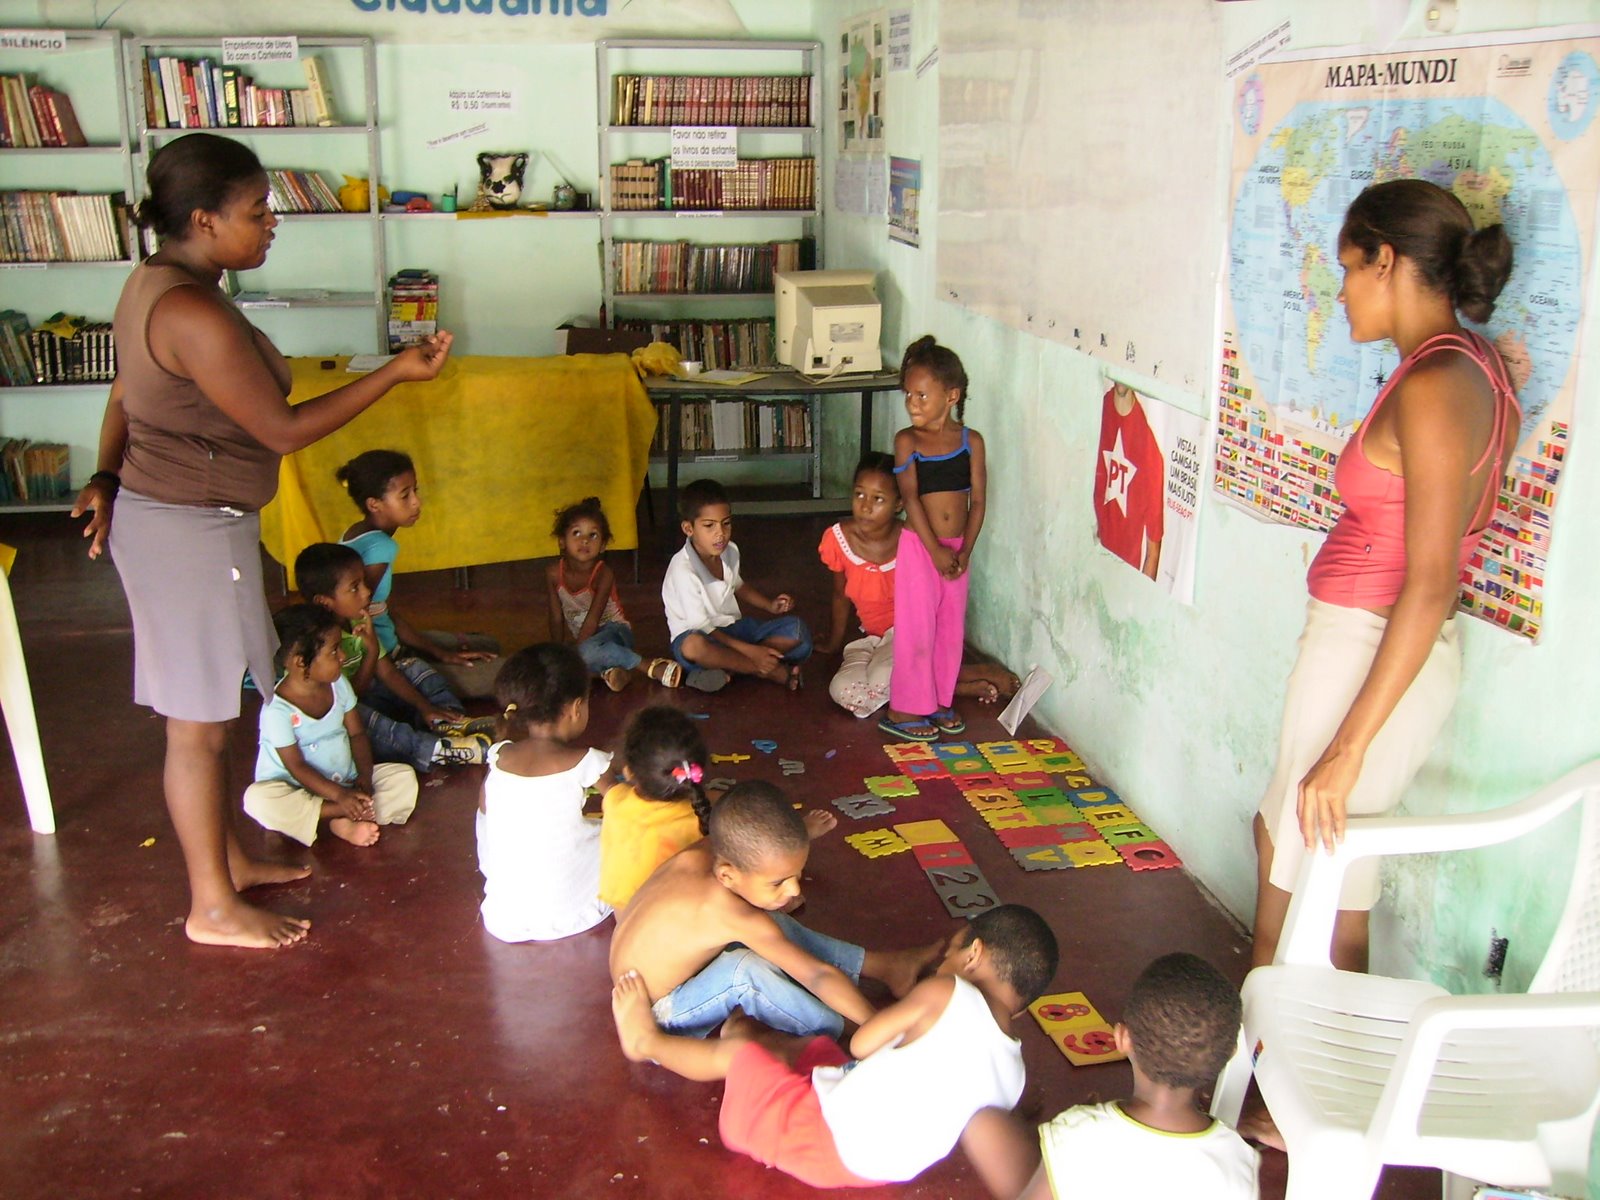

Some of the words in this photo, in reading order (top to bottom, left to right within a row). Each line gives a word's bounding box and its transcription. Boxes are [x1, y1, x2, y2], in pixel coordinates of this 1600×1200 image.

[274, 40, 292, 49] Livros
[235, 51, 250, 60] com
[1325, 58, 1457, 88] MAPA-MUNDI
[673, 129, 691, 139] Favor
[693, 130, 706, 139] não
[707, 129, 727, 139] retirar
[673, 146, 681, 155] os
[682, 145, 699, 155] livros
[700, 145, 710, 155] da
[711, 145, 737, 155] estante
[1176, 435, 1191, 453] VISTA
[1170, 450, 1192, 470] CAMISA
[1192, 461, 1200, 475] DE
[1109, 459, 1128, 494] PT
[1170, 464, 1181, 481] UM
[1180, 469, 1198, 492] BRASIL
[1167, 479, 1181, 498] MAIS
[1181, 487, 1197, 508] JUSTO
